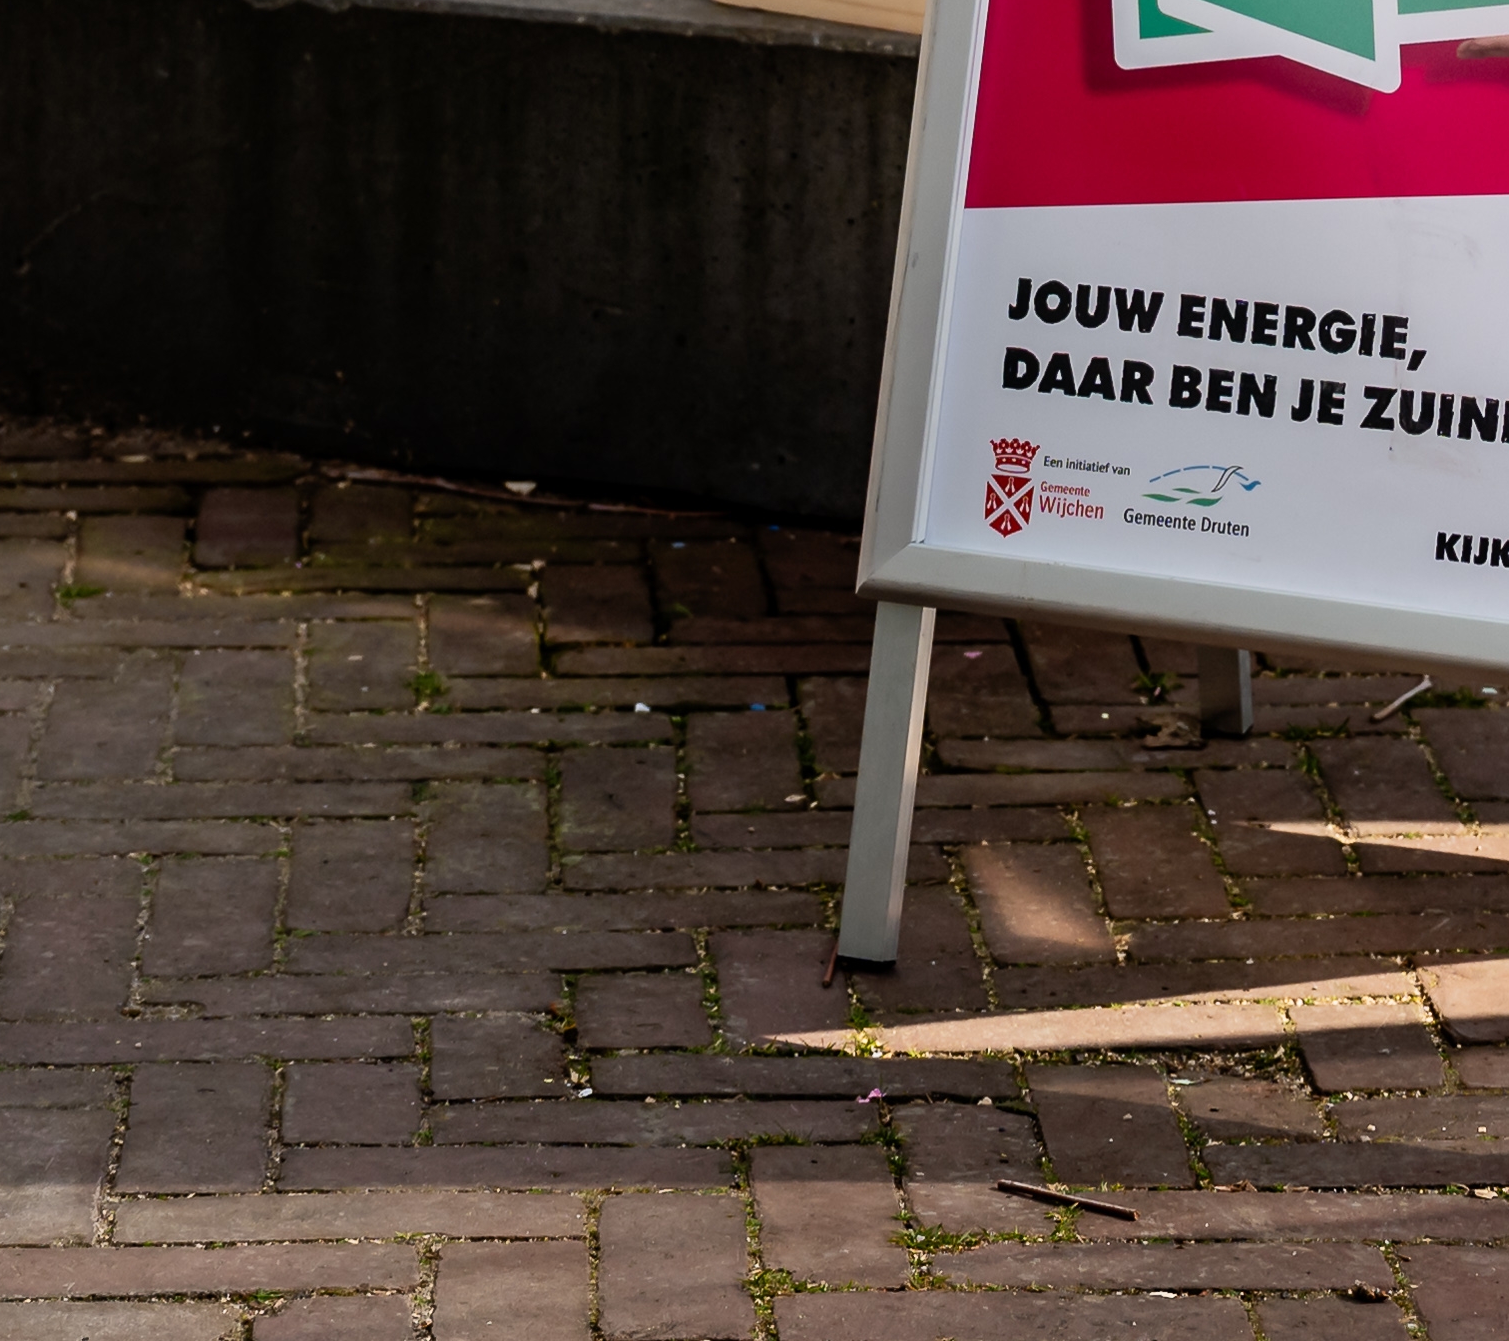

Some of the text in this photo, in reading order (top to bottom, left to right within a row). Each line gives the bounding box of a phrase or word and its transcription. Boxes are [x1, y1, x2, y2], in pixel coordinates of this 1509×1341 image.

[1008, 277, 1428, 372] JOUW ENERGIE,
[1002, 346, 1155, 405] DAAR
[1168, 363, 1278, 419] BEN
[1291, 378, 1347, 426] JE
[1043, 456, 1131, 476] Een initiatief van
[1040, 481, 1091, 498] Gemeente
[1039, 494, 1104, 520] Wijchen
[1123, 507, 1250, 538] Gemeente Druten
